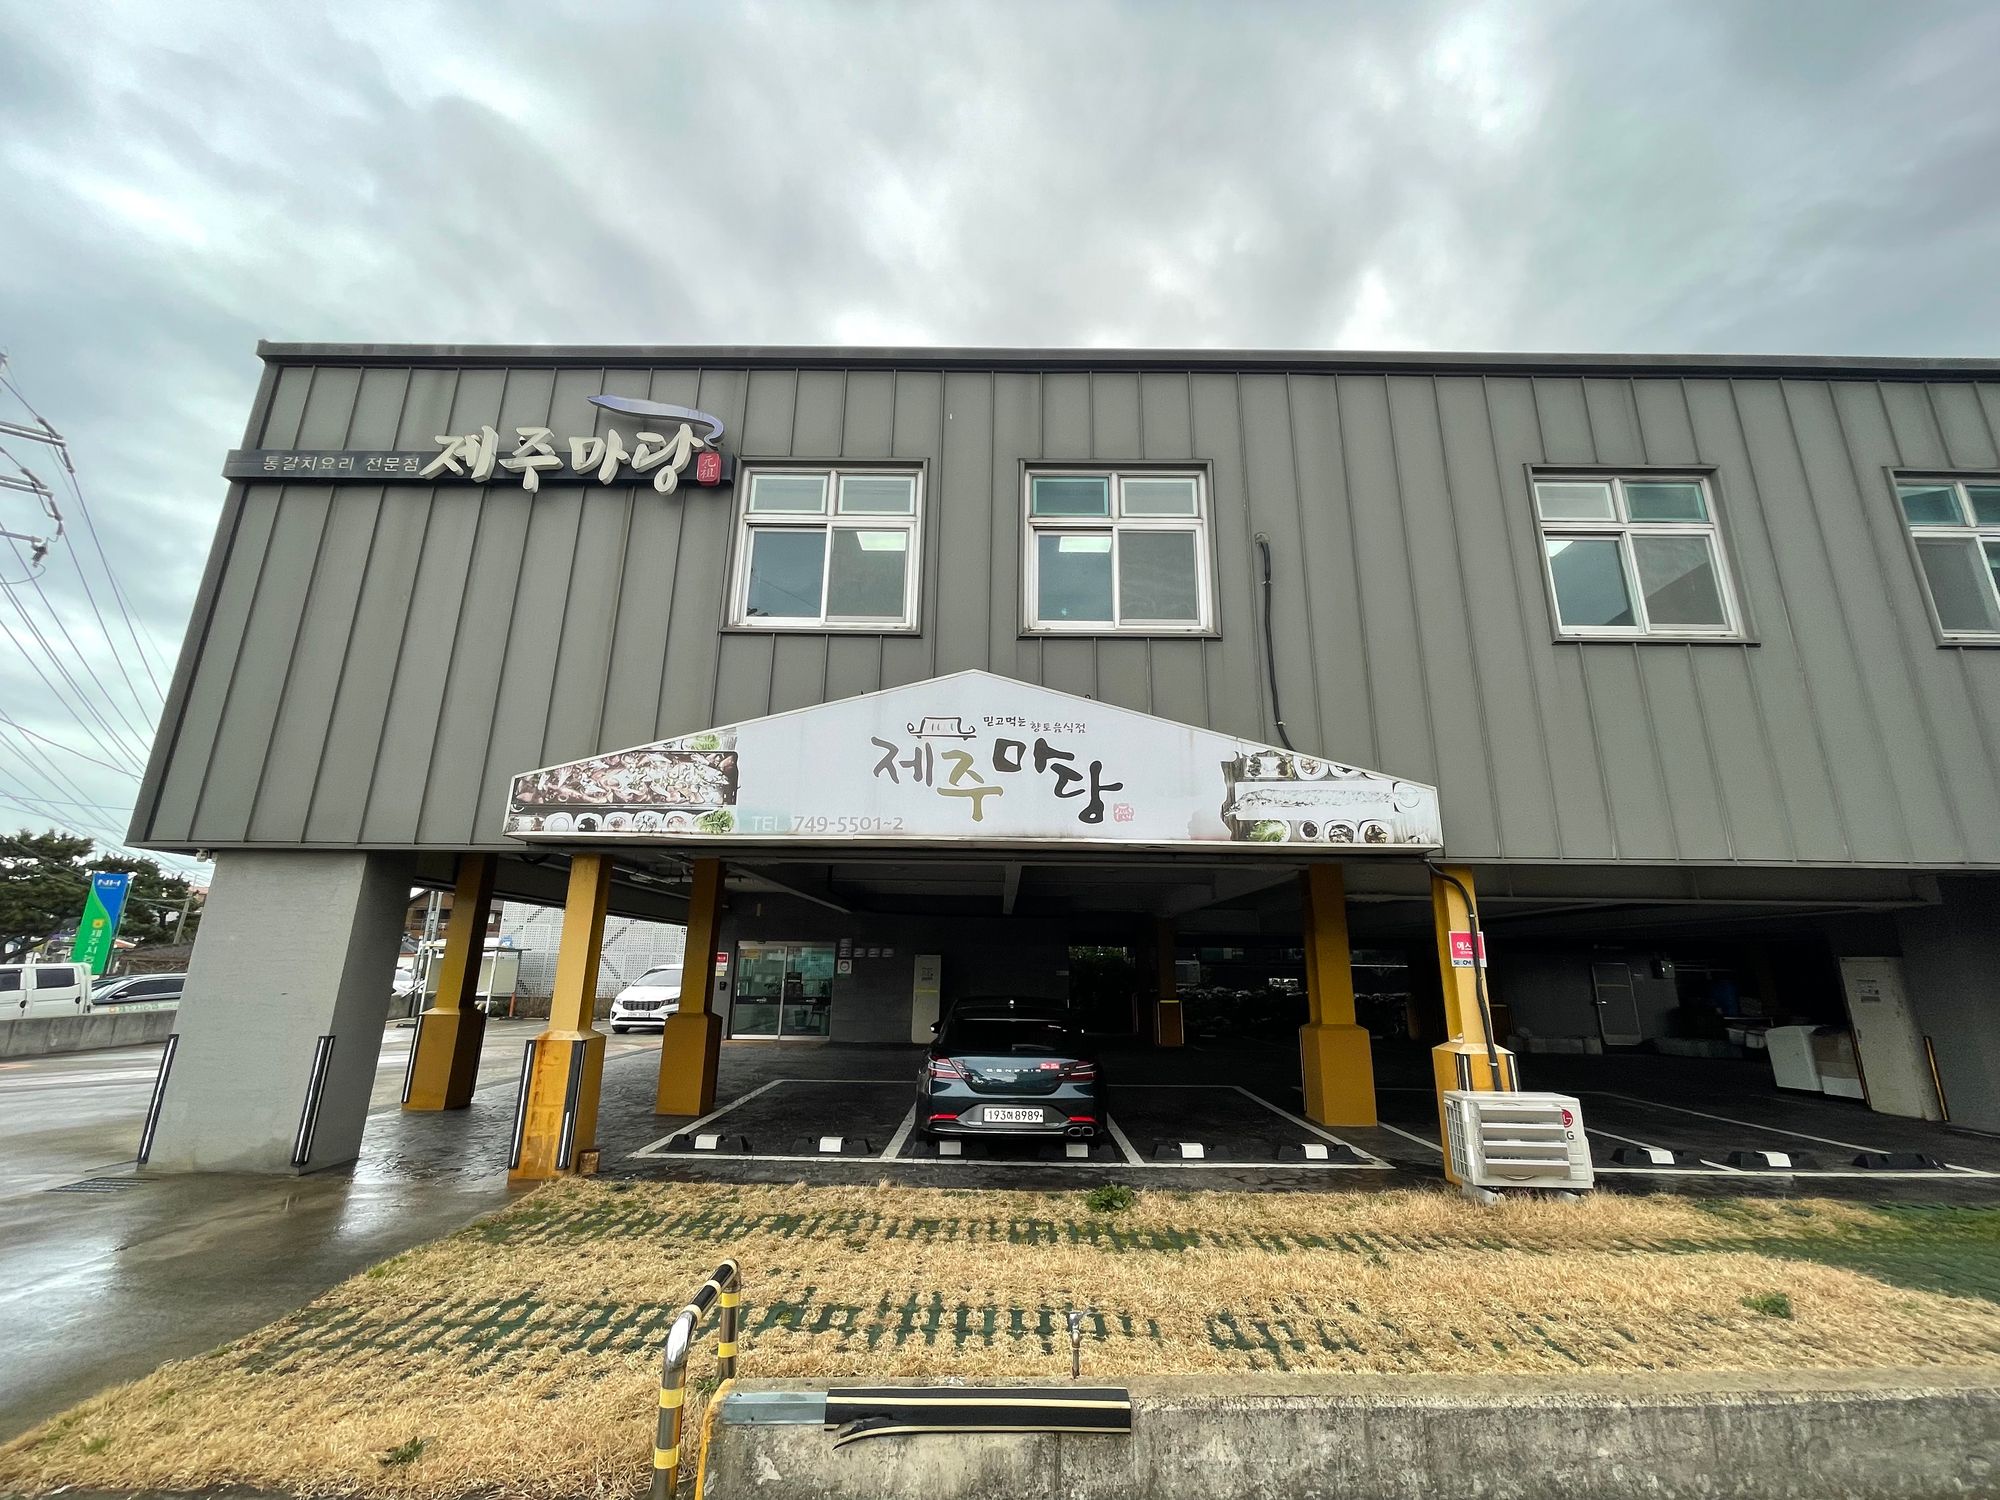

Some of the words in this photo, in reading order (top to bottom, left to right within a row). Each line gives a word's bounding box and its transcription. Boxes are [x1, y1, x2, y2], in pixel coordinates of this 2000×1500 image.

[263, 456, 354, 471] 통갈치요리
[366, 457, 419, 472] 전문점
[419, 424, 704, 496] 제주마당
[983, 716, 1026, 727] 믿고먹는
[871, 736, 1123, 824] 제주마당
[793, 815, 904, 833] 749-5501~2
